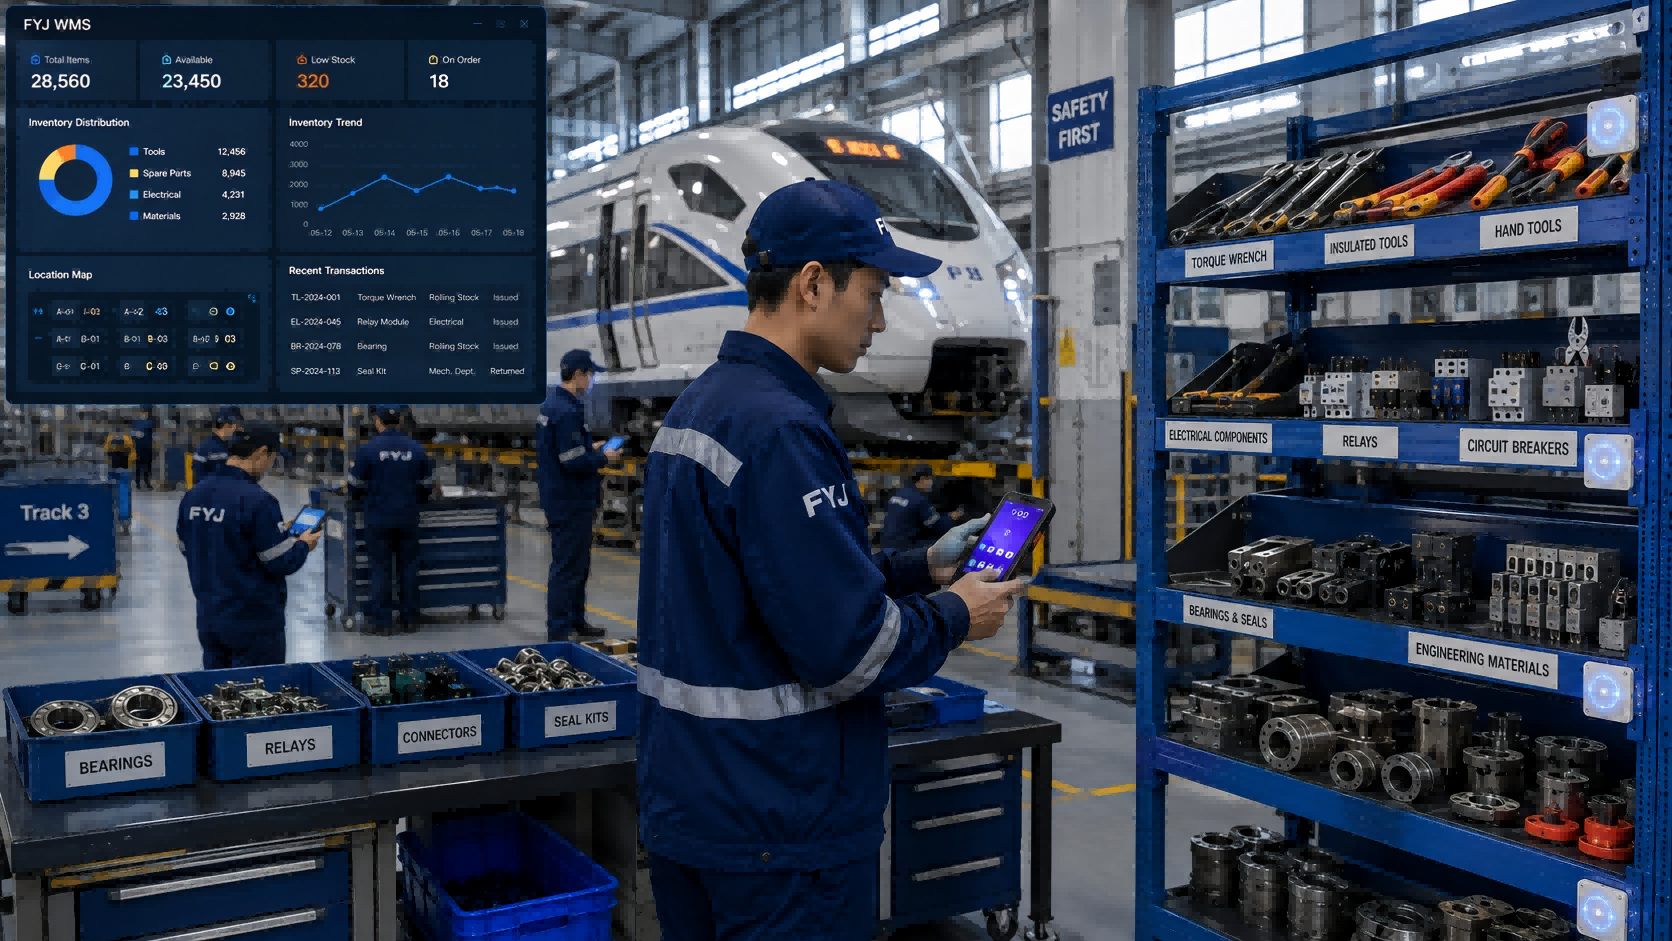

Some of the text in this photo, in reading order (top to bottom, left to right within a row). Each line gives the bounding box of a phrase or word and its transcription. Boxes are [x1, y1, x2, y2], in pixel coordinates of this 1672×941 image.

[1051, 90, 1108, 122] SAFETY
[1058, 122, 1100, 149] FIRST
[1495, 218, 1562, 239] HAND TOOLS
[1330, 234, 1409, 254] INSULATED TOOLS
[1191, 249, 1267, 269] TORQUE WRENCH
[1169, 429, 1268, 444] ELECTRICAL COMPONENTS
[1342, 434, 1378, 449] RELAYS
[1467, 438, 1570, 456] CIRCUIT BREAKERS
[802, 483, 850, 518] FYJ
[19, 503, 90, 522] Track 3
[188, 506, 226, 523] FYJ
[1189, 604, 1268, 629] BEARINGS & SEALS
[1415, 642, 1550, 678] ENGINEERING MATERIALS
[554, 711, 609, 728] SEAL KITS
[402, 725, 477, 743] CONNECTORS
[265, 738, 316, 755] RELAYS
[79, 754, 153, 775] BEARINGS
